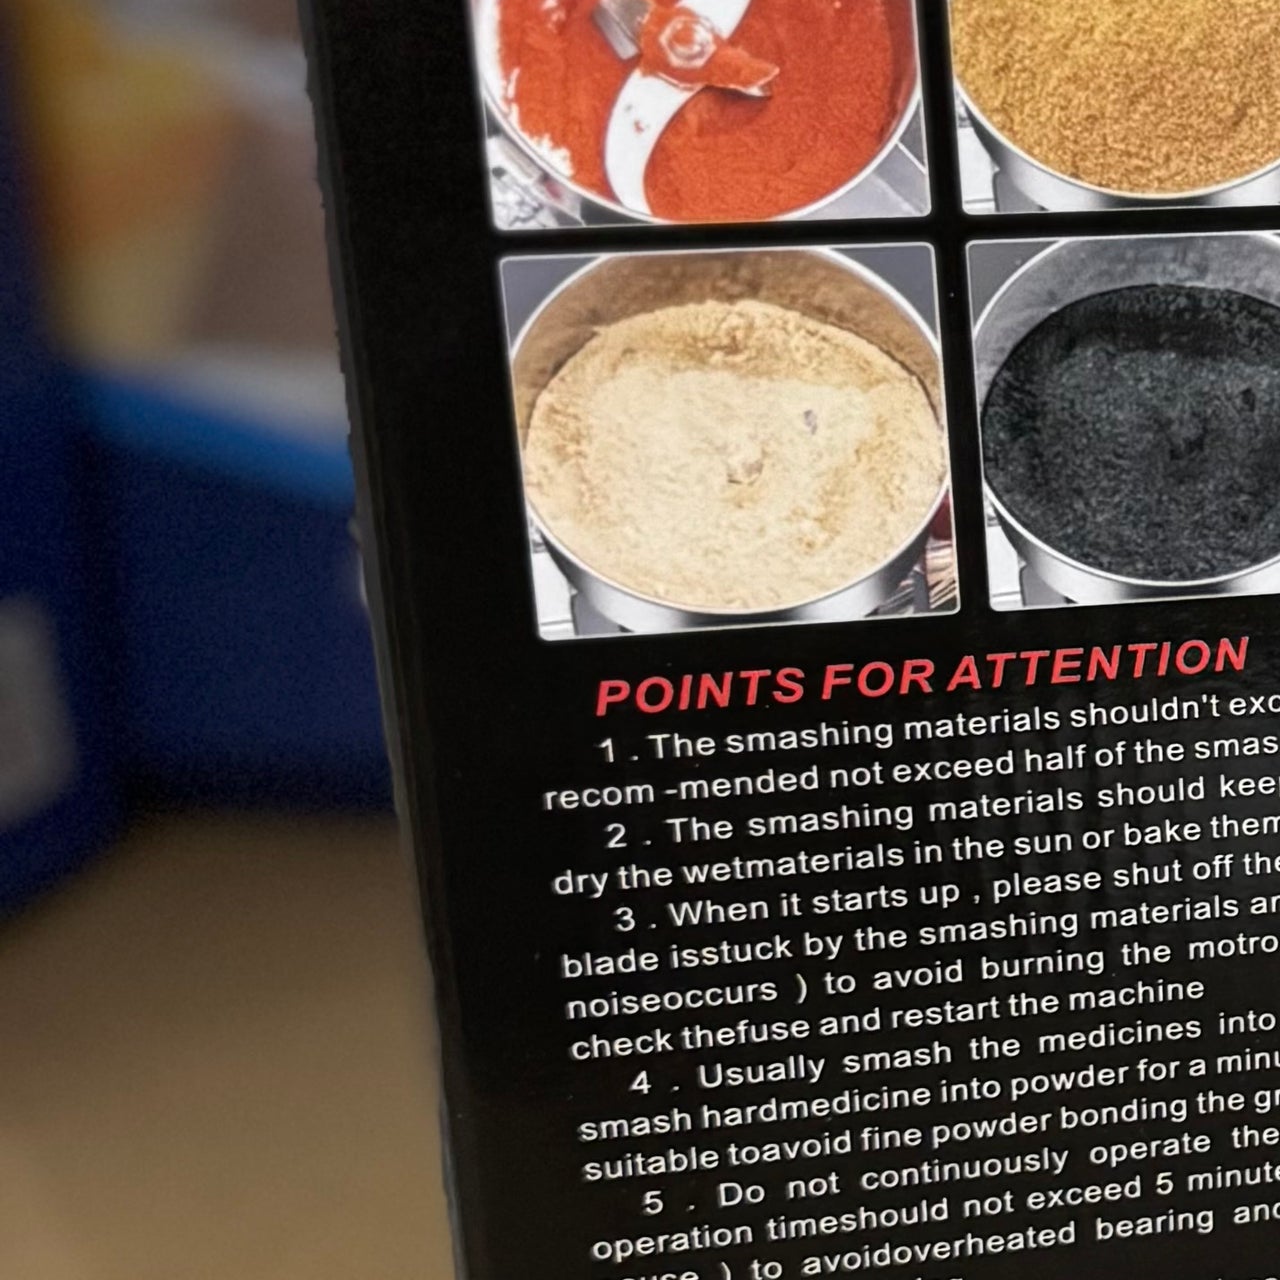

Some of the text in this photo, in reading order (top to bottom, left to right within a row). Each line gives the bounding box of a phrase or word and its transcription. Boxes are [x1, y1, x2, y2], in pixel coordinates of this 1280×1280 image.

[596, 635, 1250, 718] POINTS FOR ATTENTION
[829, 761, 885, 789] not
[891, 749, 1015, 784] exceed
[1023, 743, 1088, 773] half
[1094, 739, 1128, 768] of
[1132, 738, 1185, 765] the
[551, 868, 609, 900] dry
[616, 863, 674, 891] the
[681, 842, 905, 885] wetmaterials
[913, 839, 943, 865] in
[951, 835, 1005, 862] the
[1013, 833, 1073, 856] sun
[1081, 828, 1116, 850] or
[1123, 818, 1202, 847] bake
[561, 947, 660, 979] blade
[670, 933, 794, 969] isstuck
[803, 931, 844, 961] by
[853, 925, 908, 952] the
[918, 910, 1079, 946] smashing
[1089, 894, 1240, 930] materials
[570, 978, 1205, 1061] check thefuse and restart the machine
[582, 1145, 720, 1182] suitable
[726, 1129, 852, 1166] toavoid
[859, 1126, 923, 1152] fine
[931, 1111, 1053, 1150] powder
[1059, 1097, 1188, 1130] bonding
[1195, 1089, 1246, 1115] the
[800, 1219, 1076, 1276] avoidoverheated
[1095, 1208, 1215, 1241] bearing
